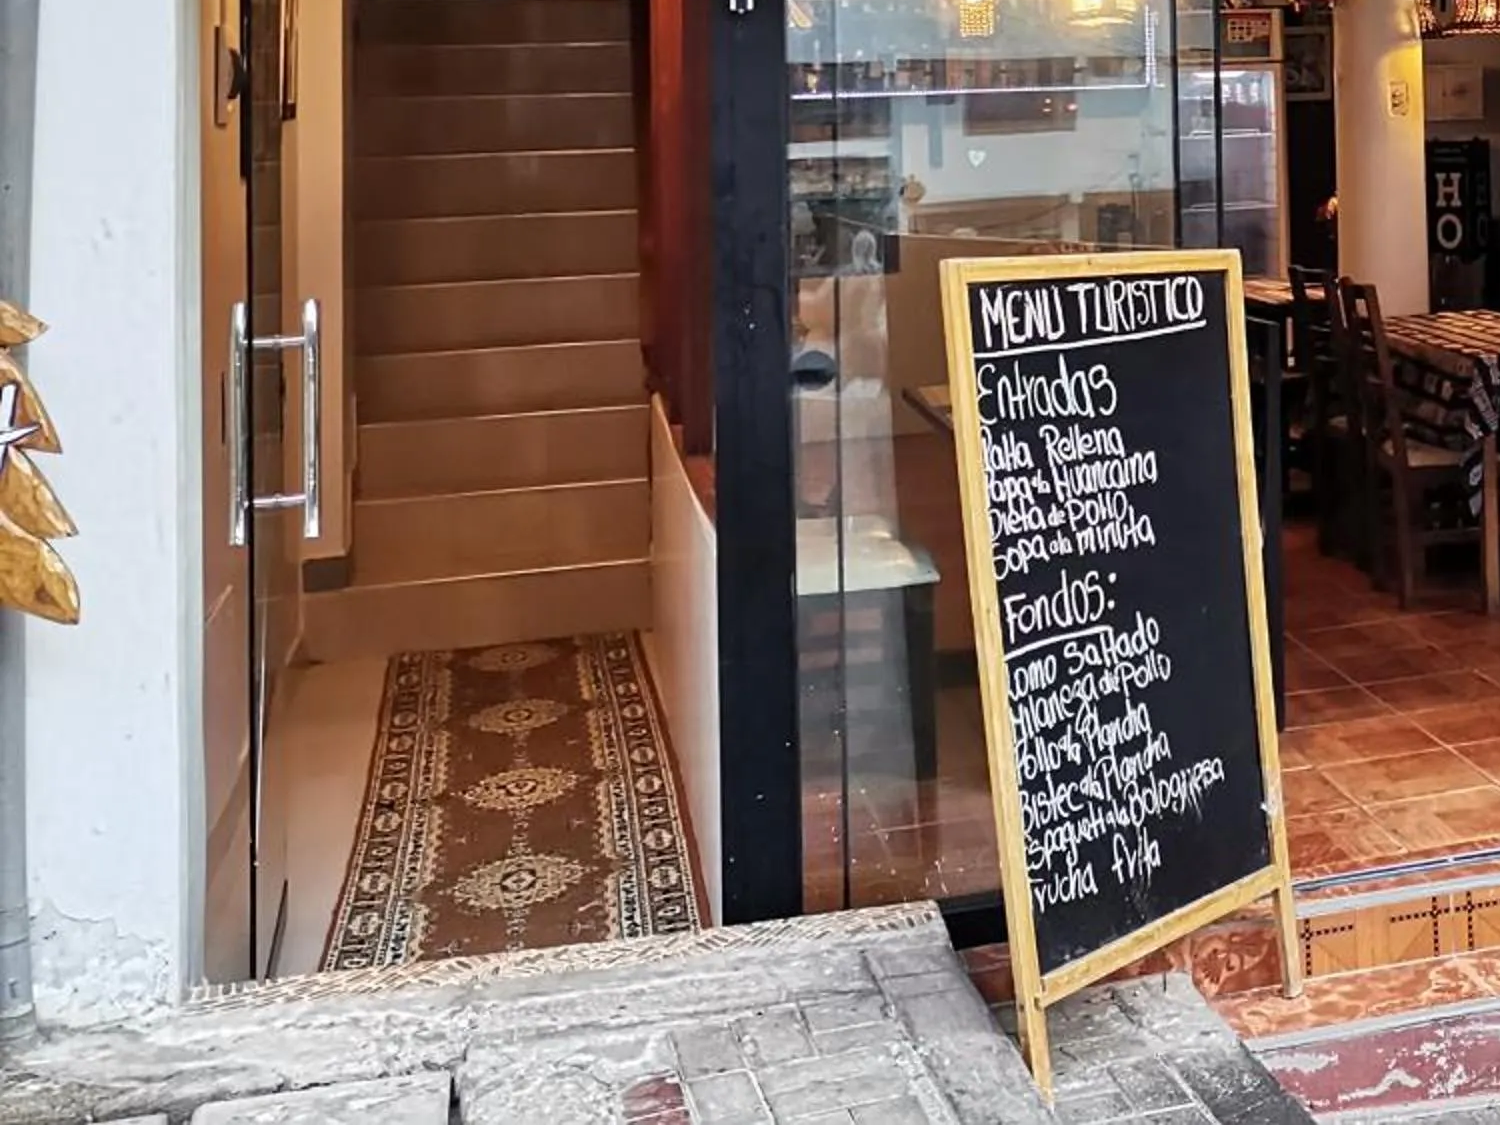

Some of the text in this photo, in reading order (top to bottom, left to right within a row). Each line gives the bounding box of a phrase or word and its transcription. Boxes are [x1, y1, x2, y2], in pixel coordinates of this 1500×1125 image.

[979, 276, 1204, 350] MENU TURISTICO
[977, 353, 1117, 425] Entradas
[1039, 423, 1126, 466] Rellena
[1048, 503, 1066, 526] de
[992, 534, 1049, 581] Sopa
[1116, 649, 1171, 698] Pollo
